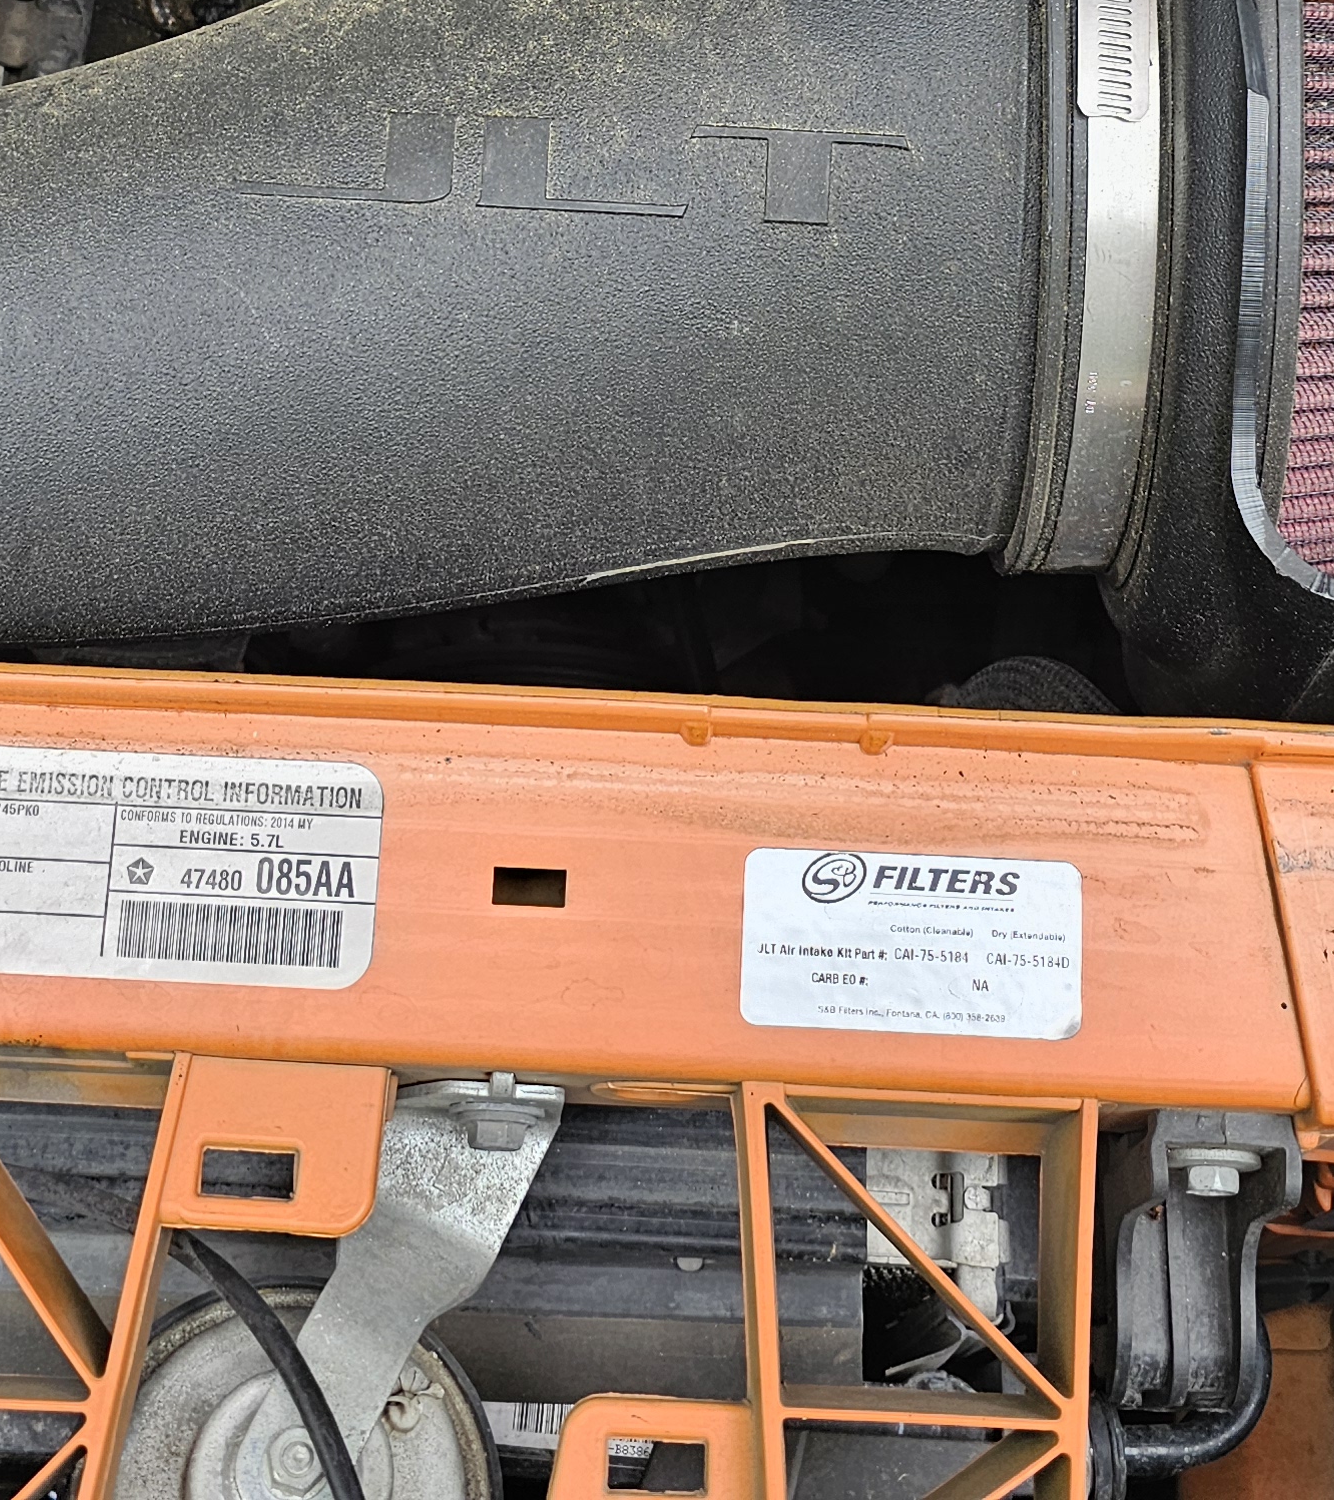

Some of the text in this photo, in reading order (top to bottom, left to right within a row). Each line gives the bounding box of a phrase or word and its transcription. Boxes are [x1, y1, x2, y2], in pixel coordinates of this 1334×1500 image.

[237, 109, 913, 225] JLT
[16, 770, 114, 800] EMISSION
[122, 775, 215, 803] CONTROL
[222, 780, 364, 811] INFORMATION
[120, 809, 315, 831] CONFORMS TO REGULATIONS: 2014 MY
[179, 829, 285, 849] ENGINE: 5.7L
[180, 856, 355, 899] 47480 085AA
[872, 865, 1021, 896] FILTERS
[890, 924, 1066, 943] Cotton (Cleanable) Dry (Extendable)
[757, 943, 776, 955] JLT
[780, 944, 796, 956] Air
[799, 945, 833, 958] Intake
[837, 947, 852, 959] Kit
[855, 948, 875, 960] Part
[894, 947, 969, 964] CAI-75-5184
[986, 952, 1070, 969] CAI-75-5184D
[811, 972, 839, 984] CARB
[842, 974, 856, 985] EO
[972, 979, 990, 992] NA
[838, 1006, 864, 1016] Filters
